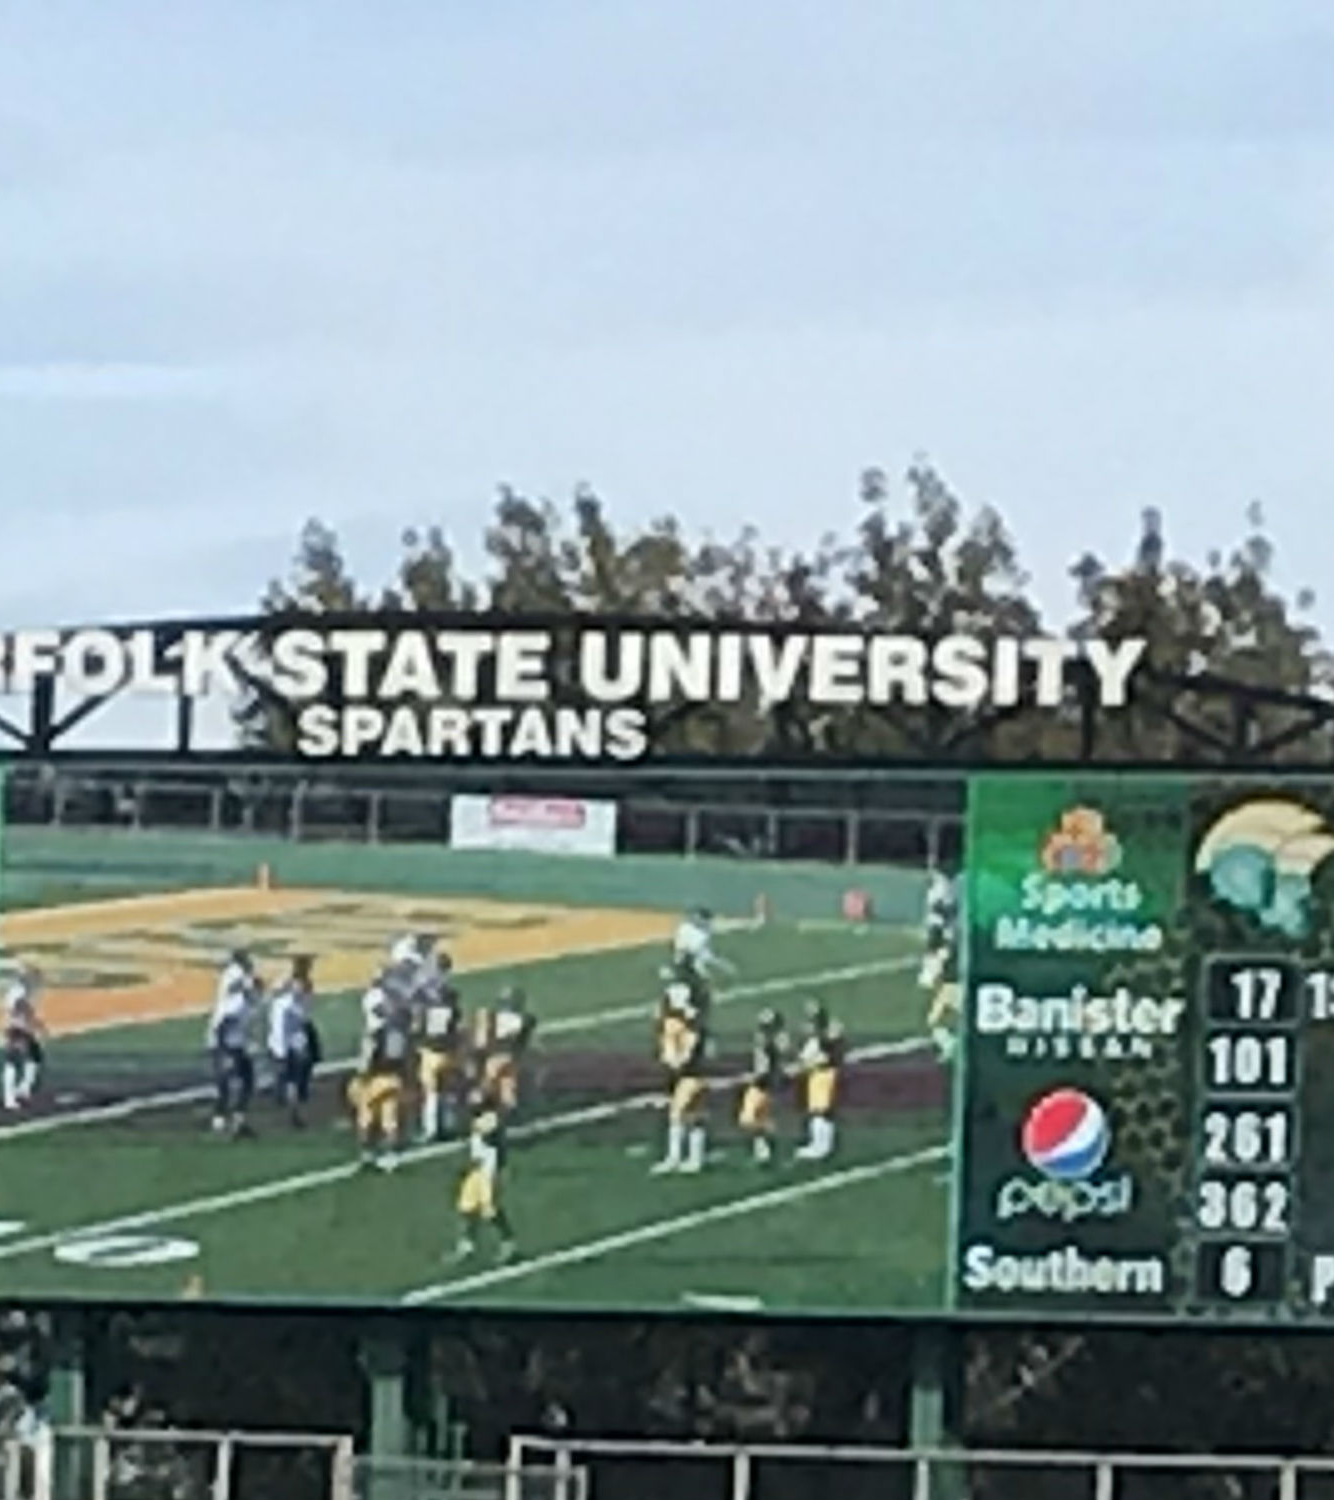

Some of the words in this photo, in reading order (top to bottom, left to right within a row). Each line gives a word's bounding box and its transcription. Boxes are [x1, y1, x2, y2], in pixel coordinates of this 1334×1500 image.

[271, 630, 549, 699] STATE
[580, 633, 1145, 706] UNIVERSITY
[297, 706, 647, 759] SPARTANS
[1021, 873, 1142, 914] Sports
[976, 983, 1185, 1035] Banister
[1230, 968, 1282, 1020] 17
[1208, 1036, 1287, 1085] 101
[1204, 1111, 1288, 1162] 261
[964, 1243, 1163, 1293] Southern
